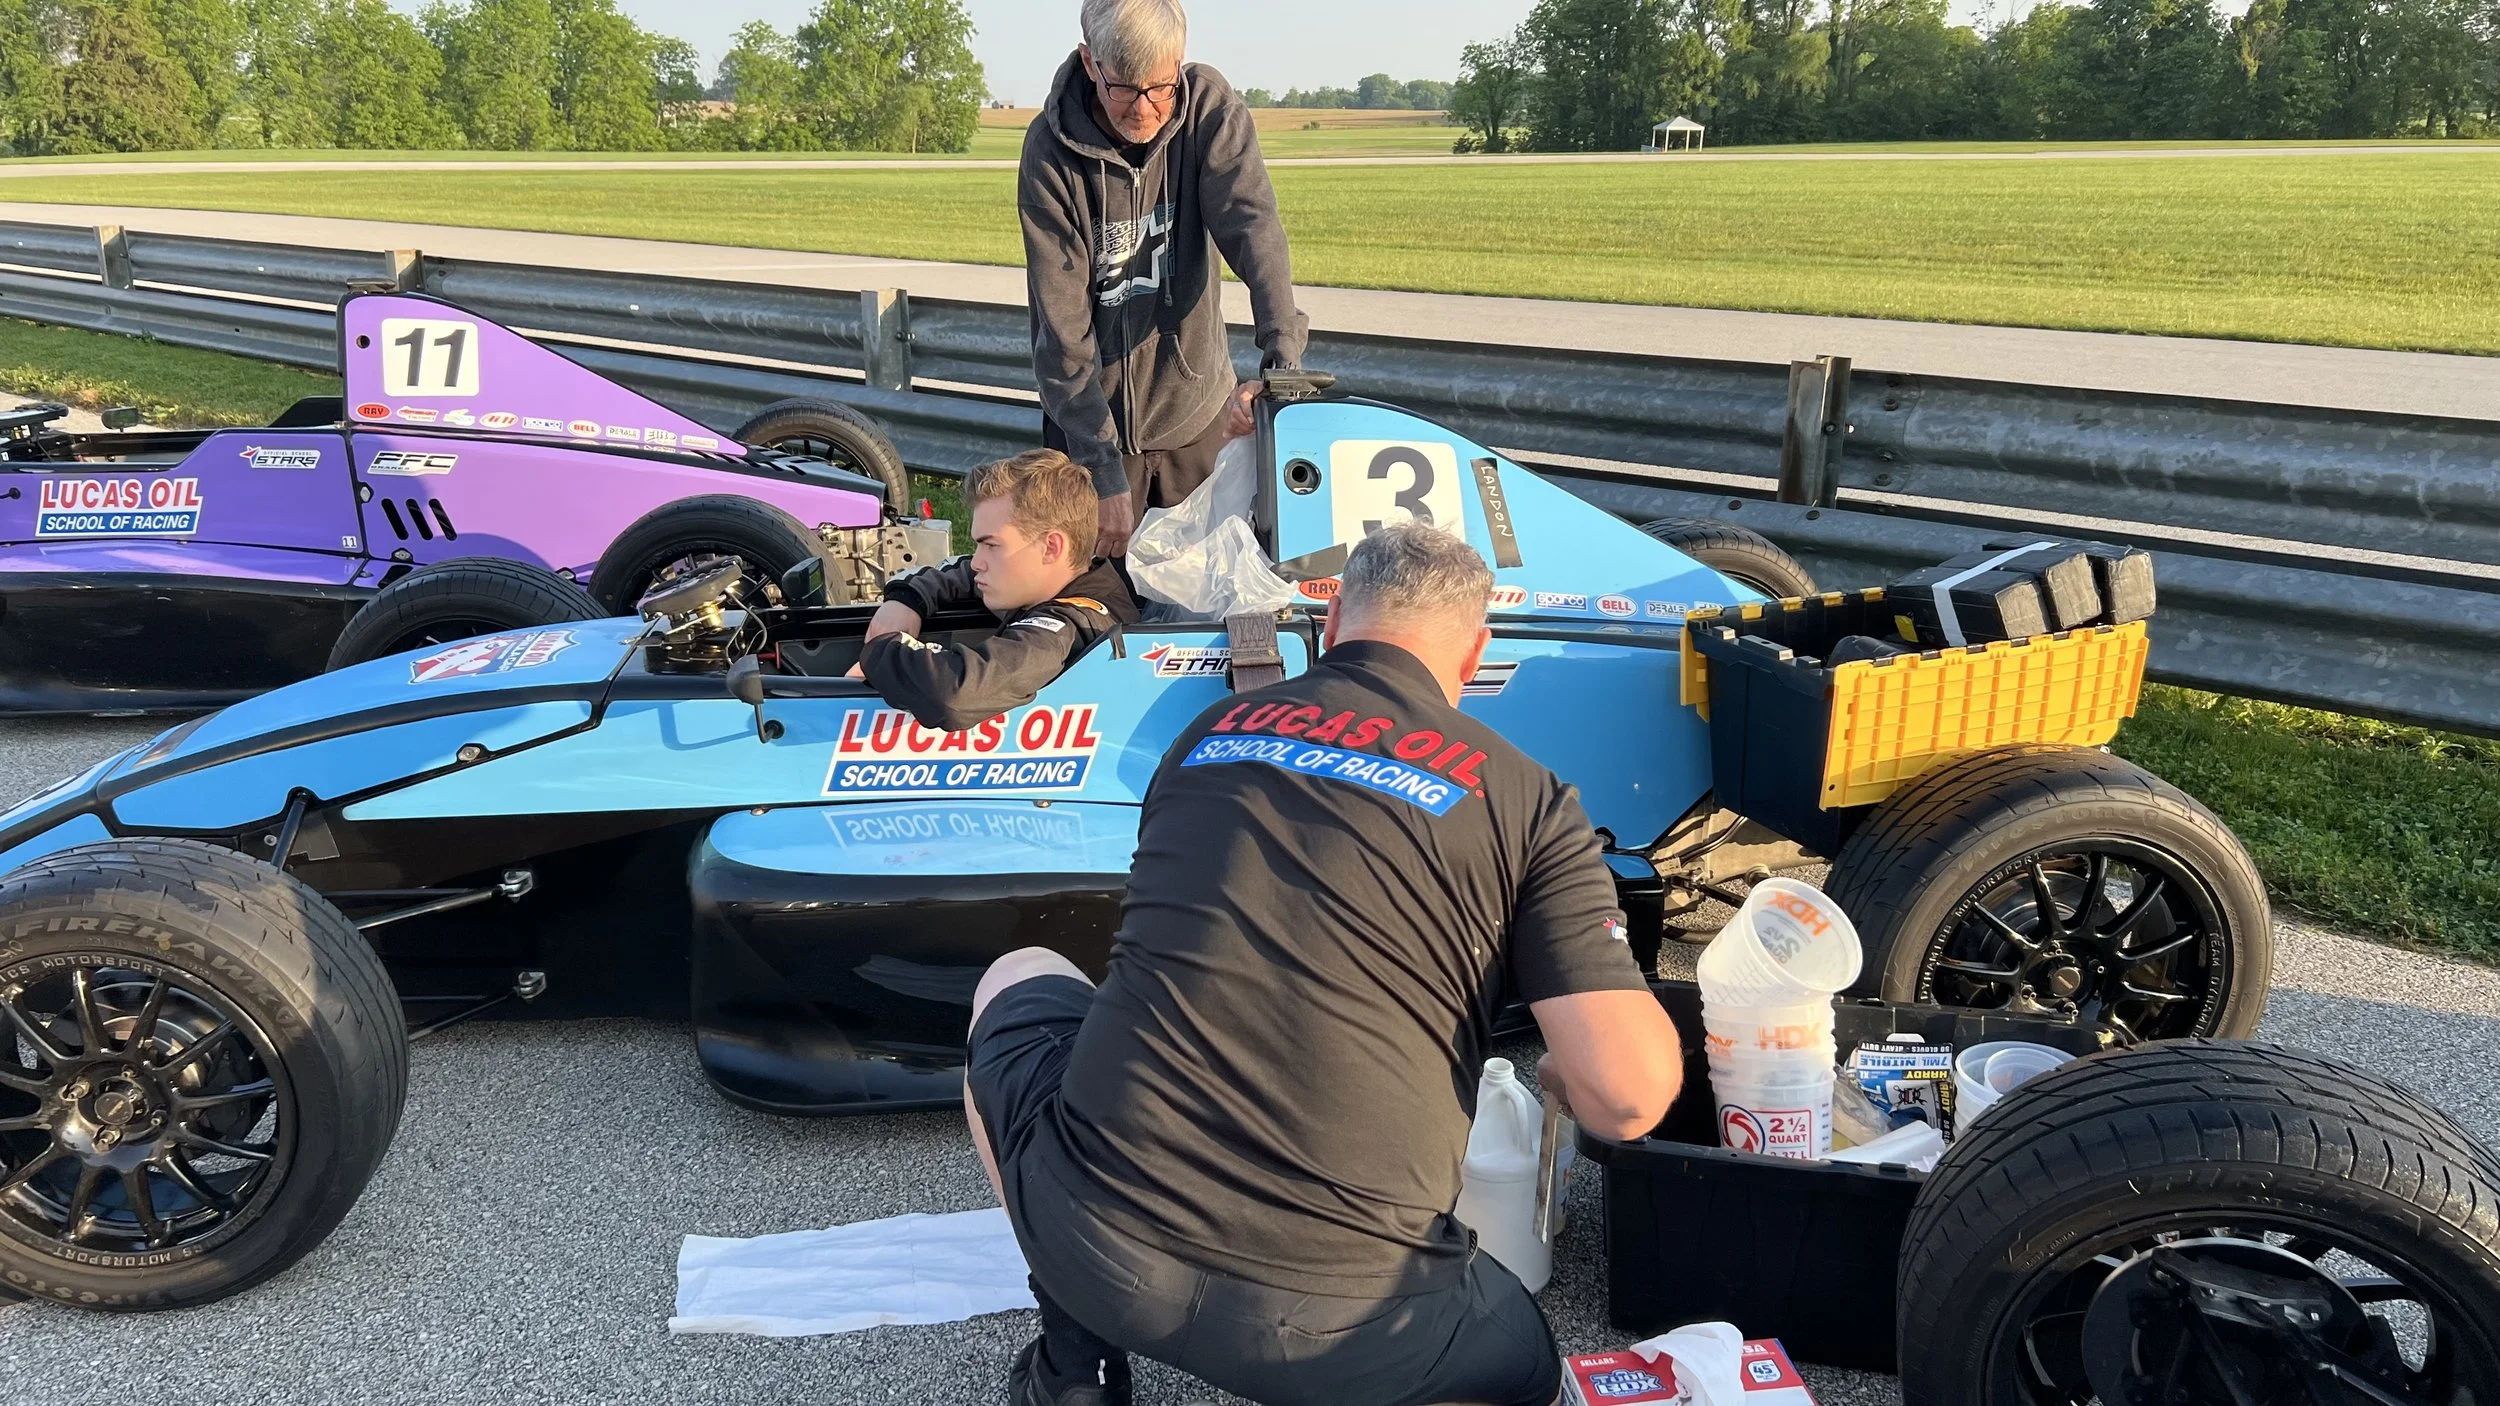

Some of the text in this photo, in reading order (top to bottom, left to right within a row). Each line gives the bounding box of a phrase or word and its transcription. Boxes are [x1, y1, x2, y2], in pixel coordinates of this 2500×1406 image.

[394, 328, 468, 388] 11
[363, 407, 384, 415] RAY
[573, 424, 596, 433] BELL
[256, 456, 317, 467] STARS
[373, 453, 456, 468] PFC
[42, 481, 200, 508] LUCAS OIL
[1362, 446, 1435, 538] 3
[1480, 465, 1513, 538] LANDON
[46, 514, 190, 530] SCHOOL OF RACING
[343, 536, 356, 547] 11
[1308, 580, 1338, 595] RAY
[1537, 593, 1585, 609] sparco
[1602, 600, 1632, 611] BELL
[1649, 604, 1684, 614] DERALE
[839, 707, 1098, 753] LUCAS OIL
[1211, 702, 1394, 748] LUCAS
[840, 760, 1078, 788] SCHOOL OF RACING
[1195, 740, 1449, 805] SCHOOL OF RACING
[41, 955, 164, 976] MOTORSPORT
[1860, 1042, 1879, 1051] DUTY
[1911, 1045, 1938, 1053] GLOVES
[1860, 1057, 1916, 1067] NITRILE
[1905, 1070, 1948, 1079] HARDY
[1768, 1133, 1808, 1144] QUART
[53, 1247, 172, 1267] MOTORSPORT
[1743, 1344, 1769, 1355] SA
[1580, 1357, 1615, 1367] SELLARS
[1752, 1364, 1773, 1374] 45
[1593, 1371, 1646, 1384] TOOL
[1597, 1378, 1658, 1394] BOX
